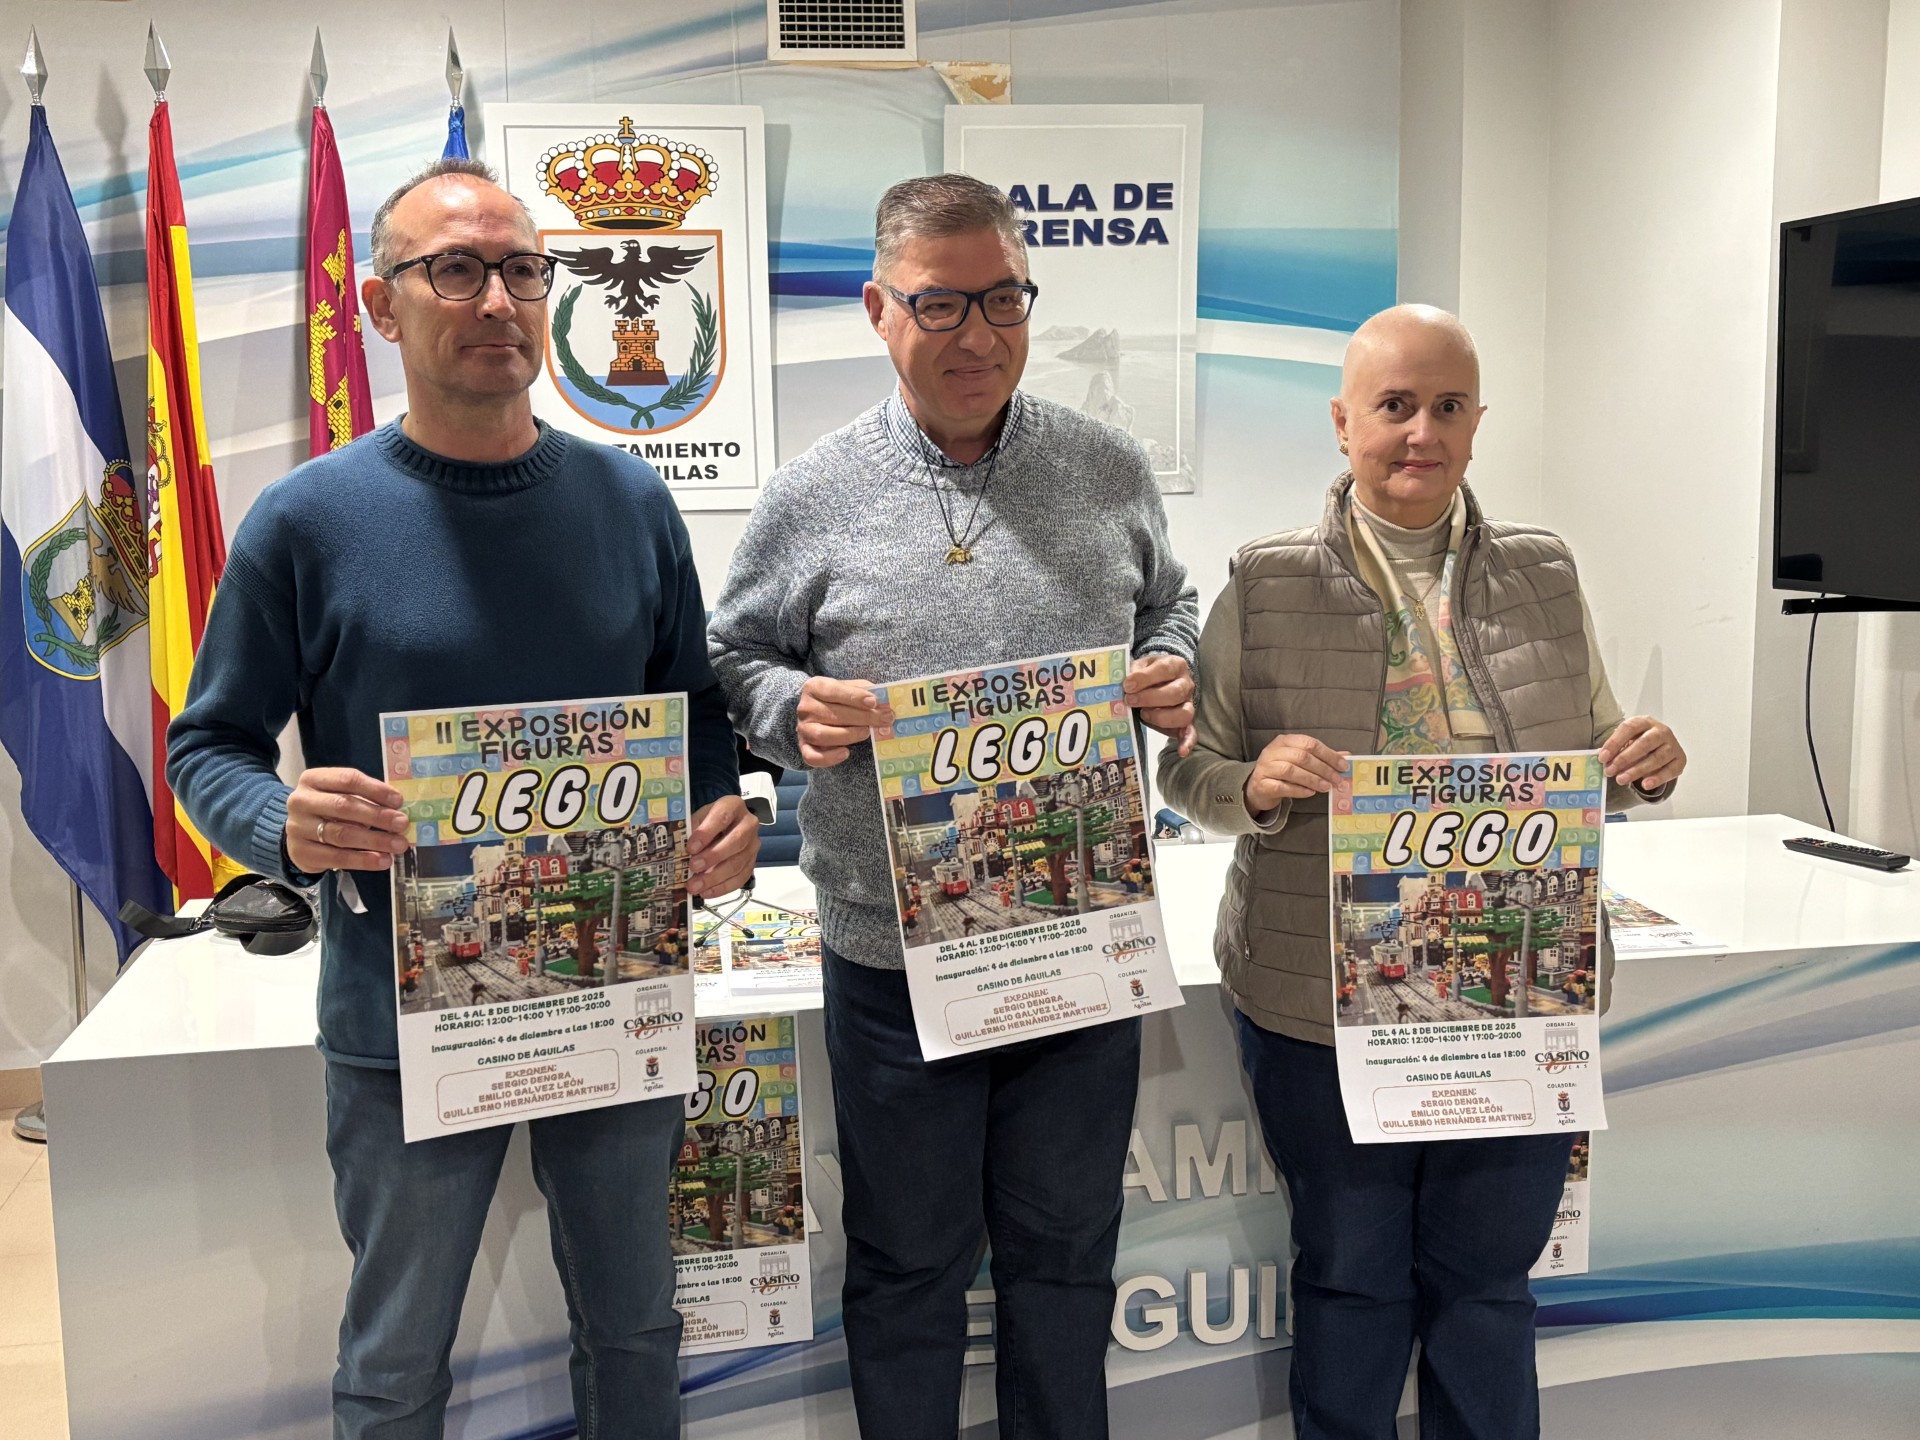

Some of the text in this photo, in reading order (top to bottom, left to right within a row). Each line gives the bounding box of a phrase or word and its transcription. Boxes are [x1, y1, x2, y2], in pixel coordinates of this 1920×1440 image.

[1007, 182, 1174, 212] ALA DE
[1020, 218, 1169, 247] RENSA
[912, 658, 1096, 706] II EXPOSICIÓN
[950, 684, 1066, 722] FIGURAS
[436, 703, 650, 744] II EXPOSICIÓN
[480, 732, 614, 764] FIGURAS
[931, 709, 1091, 785] LEGO
[1376, 758, 1572, 785] II EXPOSICIÓN
[452, 762, 642, 835] LEGO
[1412, 783, 1534, 804] FIGURAS
[1383, 810, 1558, 868] LEGO
[940, 944, 957, 953] DEL
[967, 940, 978, 948] AL
[986, 935, 998, 944] DE
[1000, 926, 1045, 941] DICIEMBRE
[1047, 923, 1058, 932] DE
[1060, 919, 1080, 929] 2025
[1102, 936, 1156, 954] CASINO
[936, 949, 978, 963] HORARIO:
[980, 939, 1028, 954] 12:00-14:00
[936, 964, 990, 982] Inauguración:
[1010, 955, 1047, 967] diciembre
[1071, 944, 1093, 954] 18:00
[977, 969, 1061, 992] CASINO DE ÁGUILAS
[440, 1012, 460, 1022] DEL
[472, 1010, 485, 1018] AL
[497, 1007, 510, 1015] DE
[513, 999, 564, 1012] DICIEMBRE
[567, 996, 580, 1004] DE
[582, 991, 605, 1001] 2025
[993, 995, 1063, 1015] SERGIO DENGRA
[1004, 988, 1048, 1004] EXPONEN:
[435, 1020, 484, 1032] HORARIO:
[488, 1012, 544, 1025] 12:00-14:00
[624, 1012, 683, 1030] CASINO
[955, 1003, 1108, 1041] GUILLERMO HERNÁNDEZ MARTINEZ
[984, 1001, 1077, 1026] EMILIO GALVEZ LEÓN
[432, 1037, 496, 1053] Inauguración:
[507, 1034, 517, 1042] de
[519, 1028, 563, 1040] diciembre
[573, 1024, 588, 1032] las
[590, 1019, 614, 1029] 18:00
[696, 1021, 766, 1046] ICIÓN
[1368, 1036, 1409, 1046] HORARIO:
[1411, 1034, 1461, 1044] 12:00-14:00
[1372, 1029, 1389, 1037] DEL
[1392, 1028, 1397, 1036] 4
[1399, 1028, 1410, 1036] AL
[1433, 1024, 1480, 1034] DICIEMBRE
[478, 1044, 575, 1065] CASINO DE ÁGUILAS
[1366, 1055, 1420, 1066] Inauguración:
[1441, 1052, 1479, 1062] diciembre
[1535, 1050, 1590, 1062] CASINO
[491, 1071, 571, 1091] SERGIO DENGRA
[505, 1064, 557, 1079] EXPONEN:
[1406, 1074, 1438, 1082] CASINO
[1454, 1070, 1491, 1079] ÁGUILAS
[443, 1082, 616, 1119] GUILLERMO HERNÁNDEZ MARTINEZ
[479, 1078, 584, 1103] EMILIO GALVEZ LEÓN
[684, 1068, 759, 1121] GO
[1432, 1088, 1477, 1098] EXPONEN:
[1411, 1104, 1502, 1118] EMILIO GALVEZ LEÓN
[1421, 1097, 1490, 1108] SERGIO DENGRA
[1383, 1112, 1532, 1128] GUILLERMO HERNÁNDEZ MARTINEZ
[1556, 1210, 1581, 1219] SINO
[714, 1254, 733, 1262] 2025
[722, 1276, 742, 1284] 18:00
[750, 1274, 800, 1286] CASINO
[684, 1318, 707, 1326] NGRA
[696, 1323, 718, 1332] LEÓN
[704, 1329, 745, 1339] MARTINEZ
